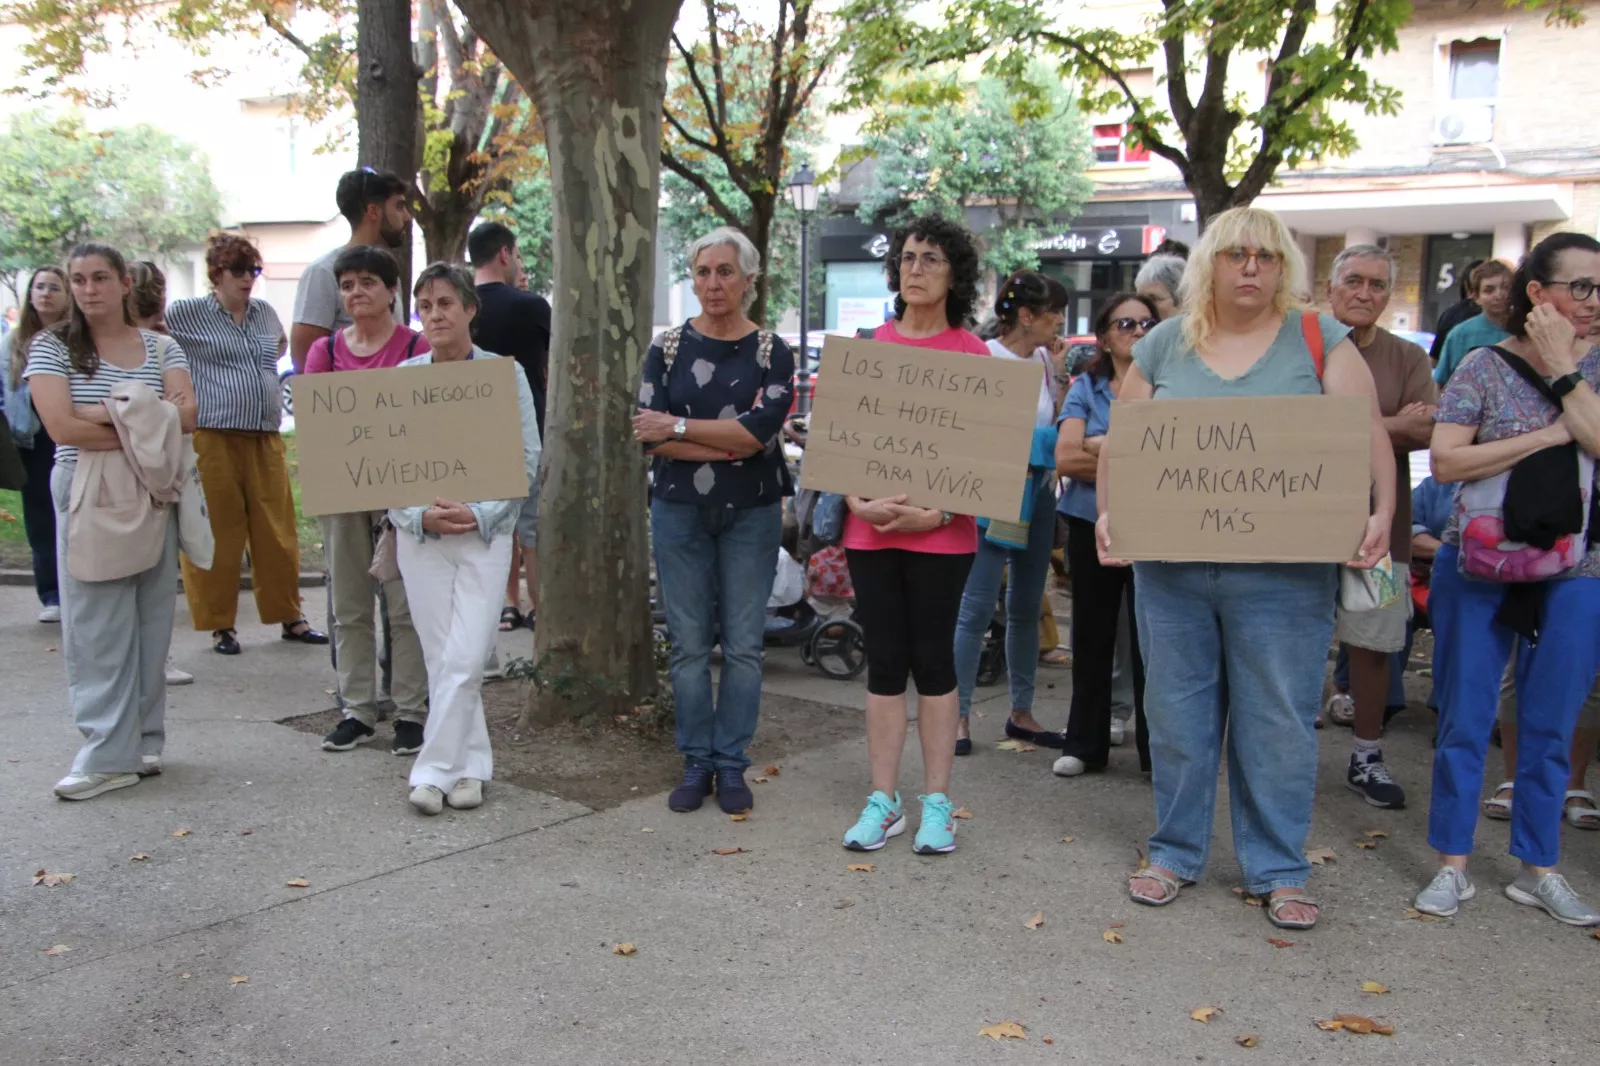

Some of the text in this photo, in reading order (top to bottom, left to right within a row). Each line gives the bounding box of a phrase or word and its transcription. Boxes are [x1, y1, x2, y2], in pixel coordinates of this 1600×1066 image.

[1436, 262, 1454, 291] 5
[842, 351, 1007, 398] LOS TURISTAS
[312, 380, 494, 414] NO AL NEGOCIO
[857, 395, 966, 431] AL HOTEL
[346, 423, 407, 446] DE LA
[828, 421, 939, 460] LAS CASAS
[1140, 416, 1256, 452] NI UNA
[345, 456, 468, 488] VIVIENDA
[865, 460, 984, 502] PARA VIVIR
[1156, 463, 1323, 498] MARICARMEN
[1200, 508, 1255, 533] MÁS
